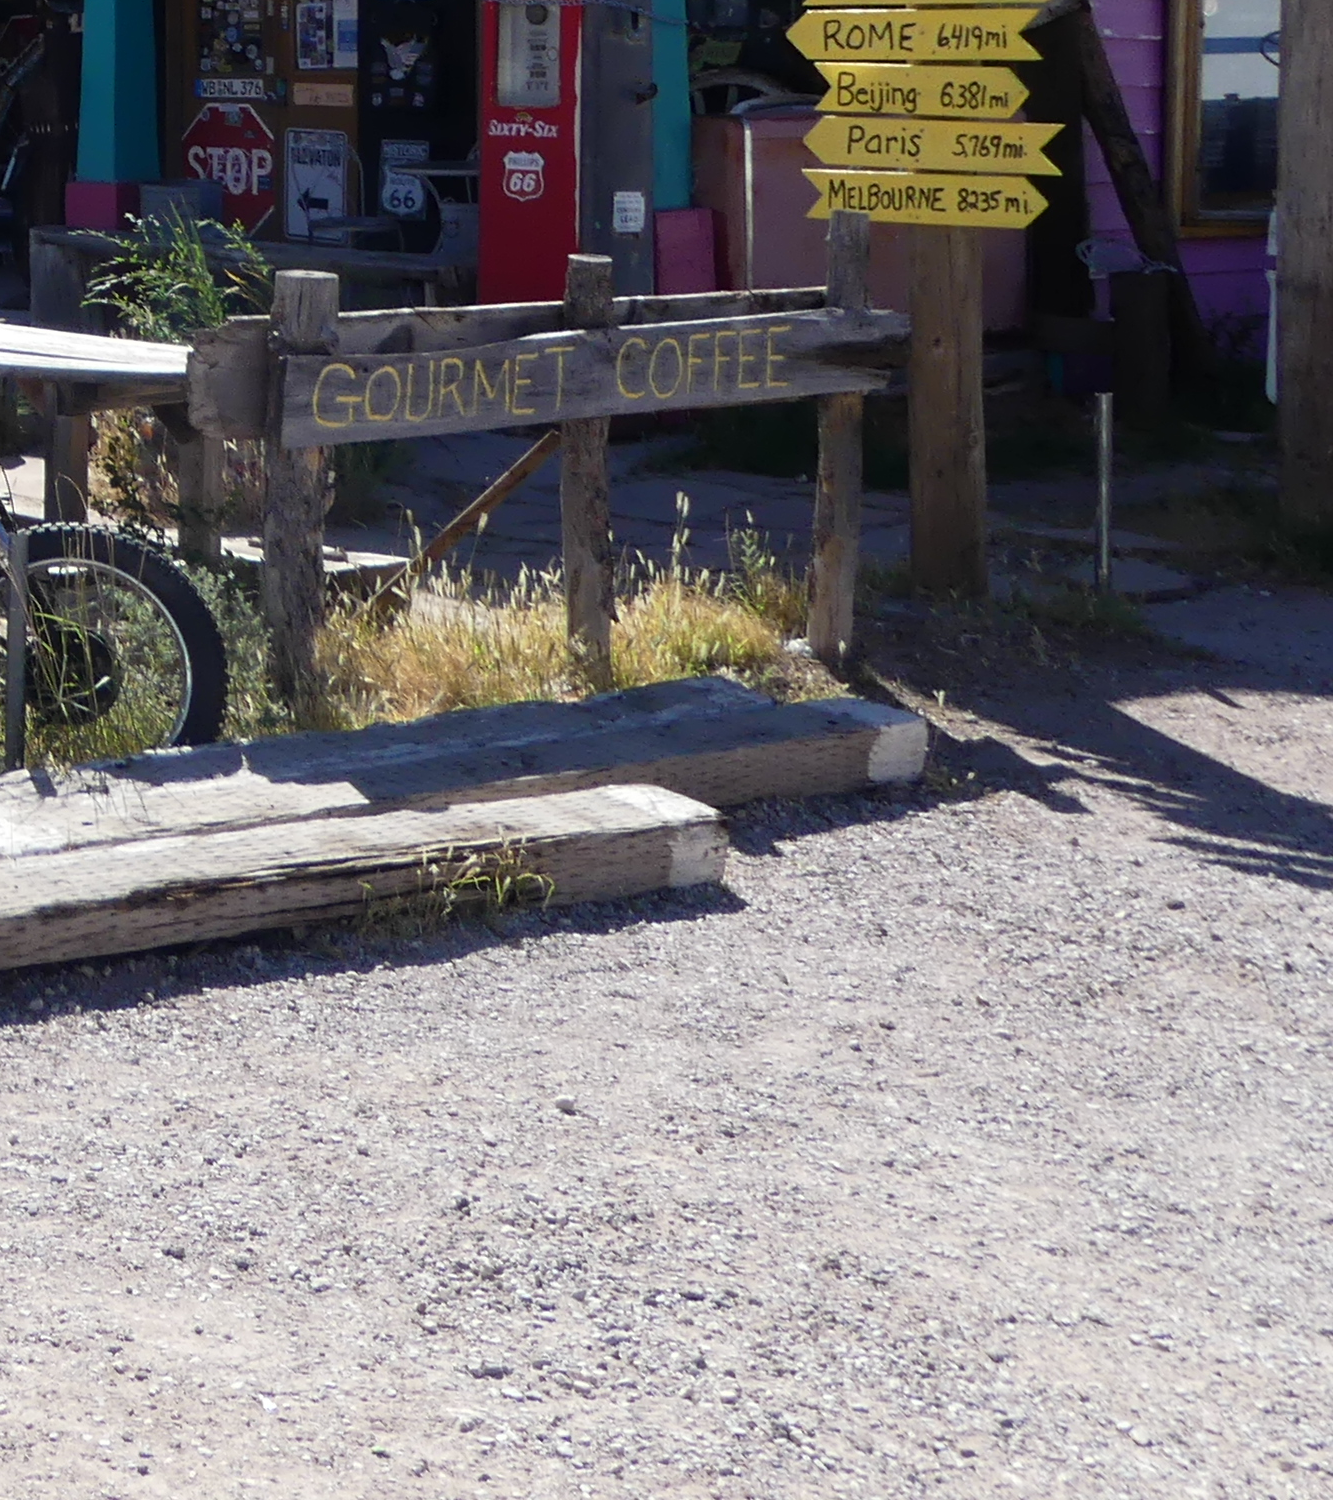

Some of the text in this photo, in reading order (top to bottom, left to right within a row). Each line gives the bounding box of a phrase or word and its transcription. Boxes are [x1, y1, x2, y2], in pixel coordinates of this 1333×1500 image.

[823, 20, 917, 51] ROME
[241, 80, 263, 96] 376
[837, 72, 919, 113] Beijing
[847, 125, 921, 157] Paris
[188, 145, 273, 195] STOP
[510, 172, 537, 192] 66
[391, 188, 415, 209] 66
[828, 179, 946, 212] MELBOURNE
[312, 325, 792, 428] GOURMET COFFEE
